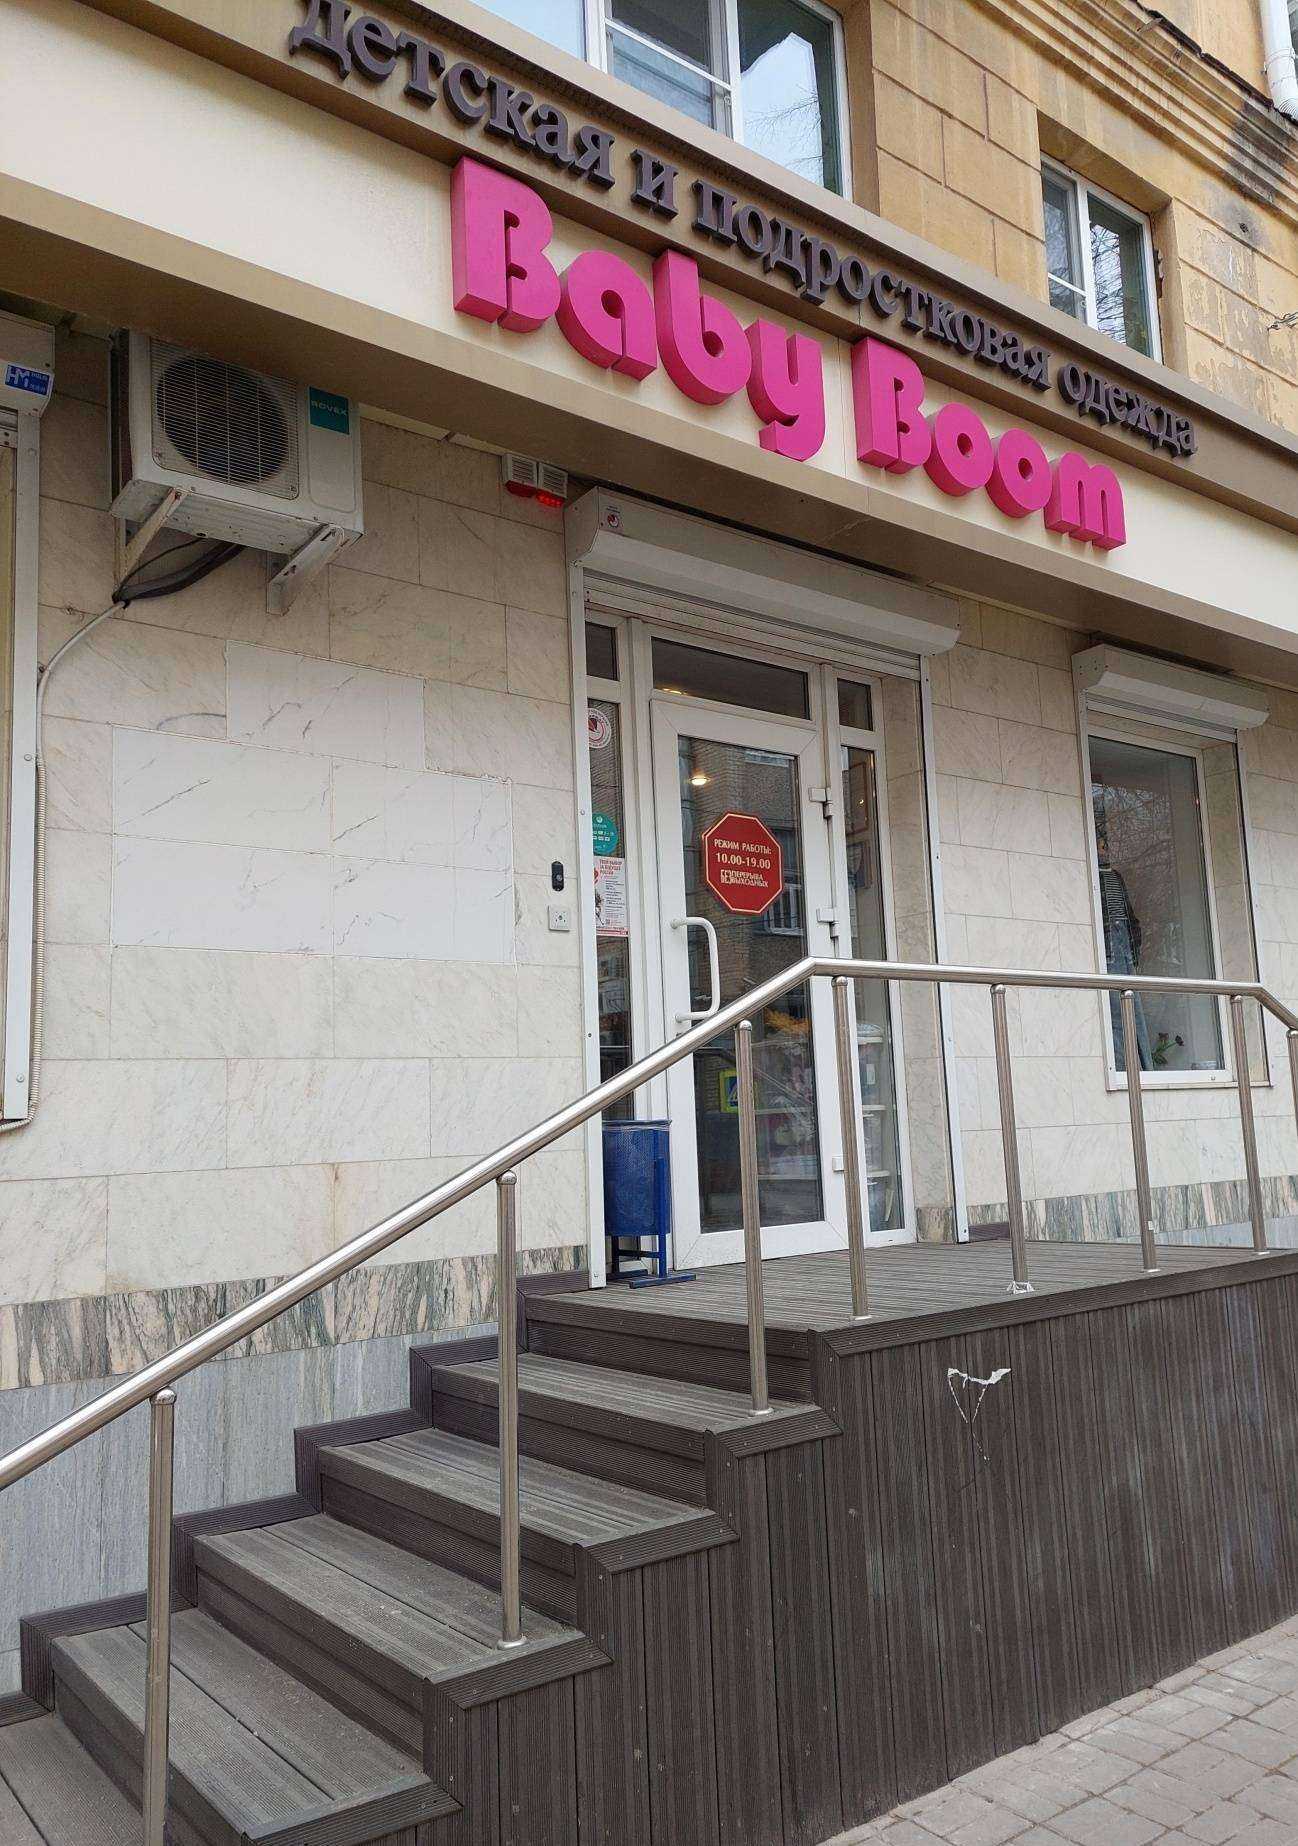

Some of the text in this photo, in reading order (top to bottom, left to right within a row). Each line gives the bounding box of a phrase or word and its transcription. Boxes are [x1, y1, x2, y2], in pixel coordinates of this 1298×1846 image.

[451, 156, 1127, 549] Baby Boom
[630, 149, 679, 220] и
[692, 178, 1052, 392] подростковая
[1057, 361, 1198, 458] одежда
[714, 839, 771, 854] РЕЖИМ РАБОТЫ:
[716, 853, 770, 869] 10.00-19.00
